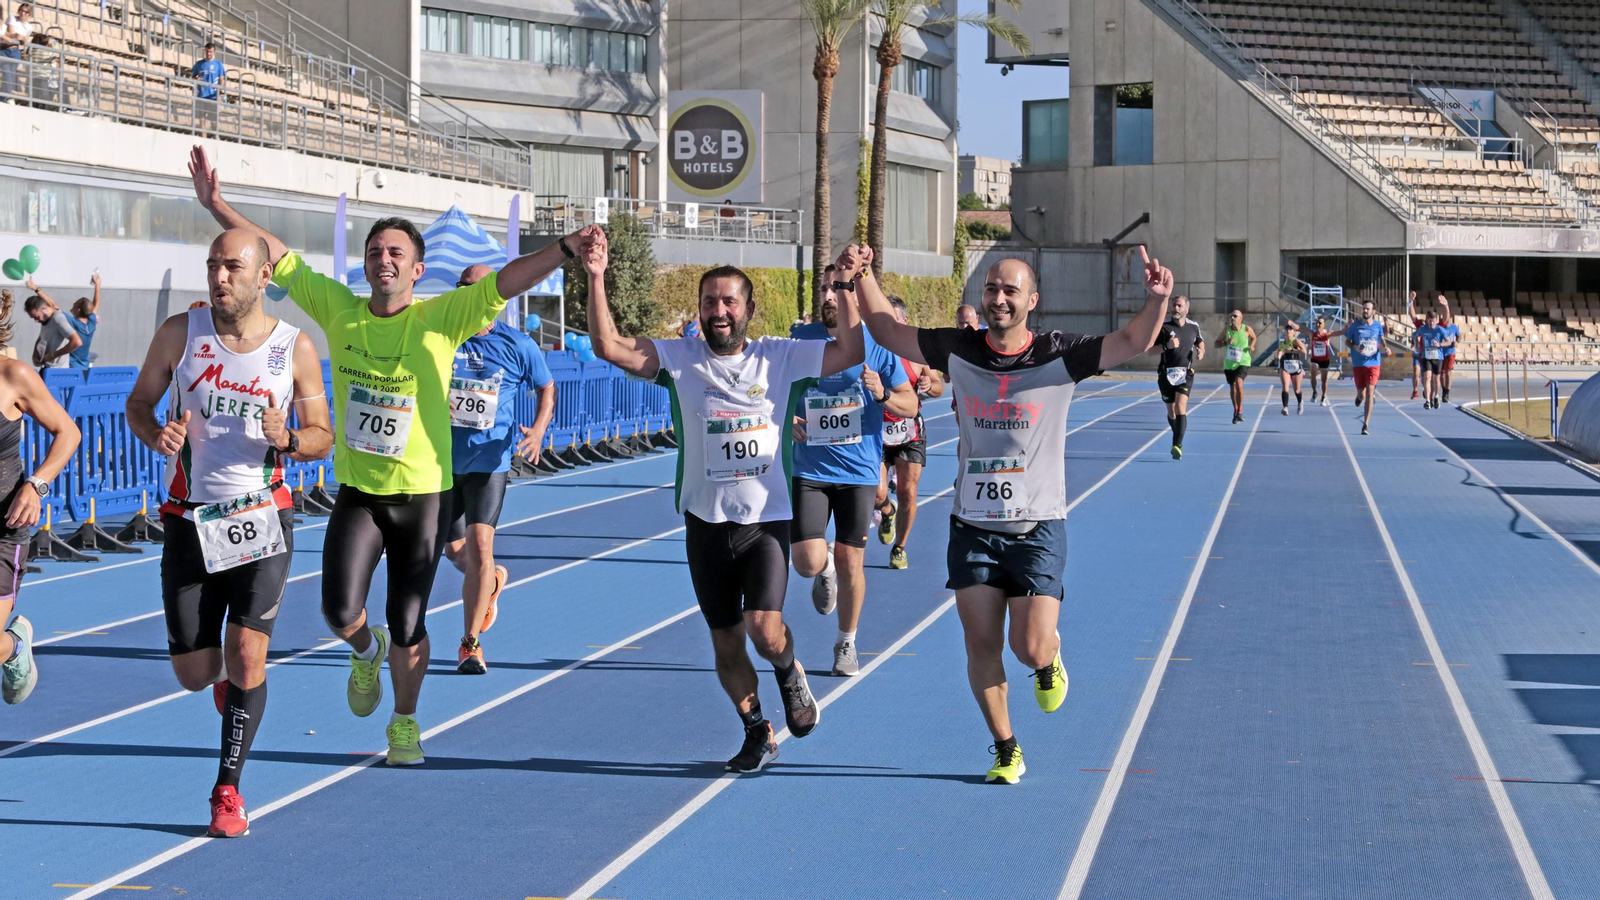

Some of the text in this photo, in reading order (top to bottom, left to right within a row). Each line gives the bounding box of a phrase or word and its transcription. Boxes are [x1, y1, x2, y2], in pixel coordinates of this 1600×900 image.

[674, 130, 745, 160] B&B
[683, 162, 734, 173] HOTELS
[1438, 228, 1506, 247] Cruzcampo
[338, 365, 414, 383] CARRERA POPULAR
[380, 385, 400, 393] 2020
[455, 396, 486, 414] 796
[963, 396, 1045, 426] Sherry
[359, 411, 397, 437] 705
[819, 414, 850, 430] 606
[886, 423, 908, 435] 616
[974, 417, 1029, 430] Maratón
[721, 439, 759, 460] 190
[975, 481, 1013, 500] 786
[227, 521, 257, 545] 68
